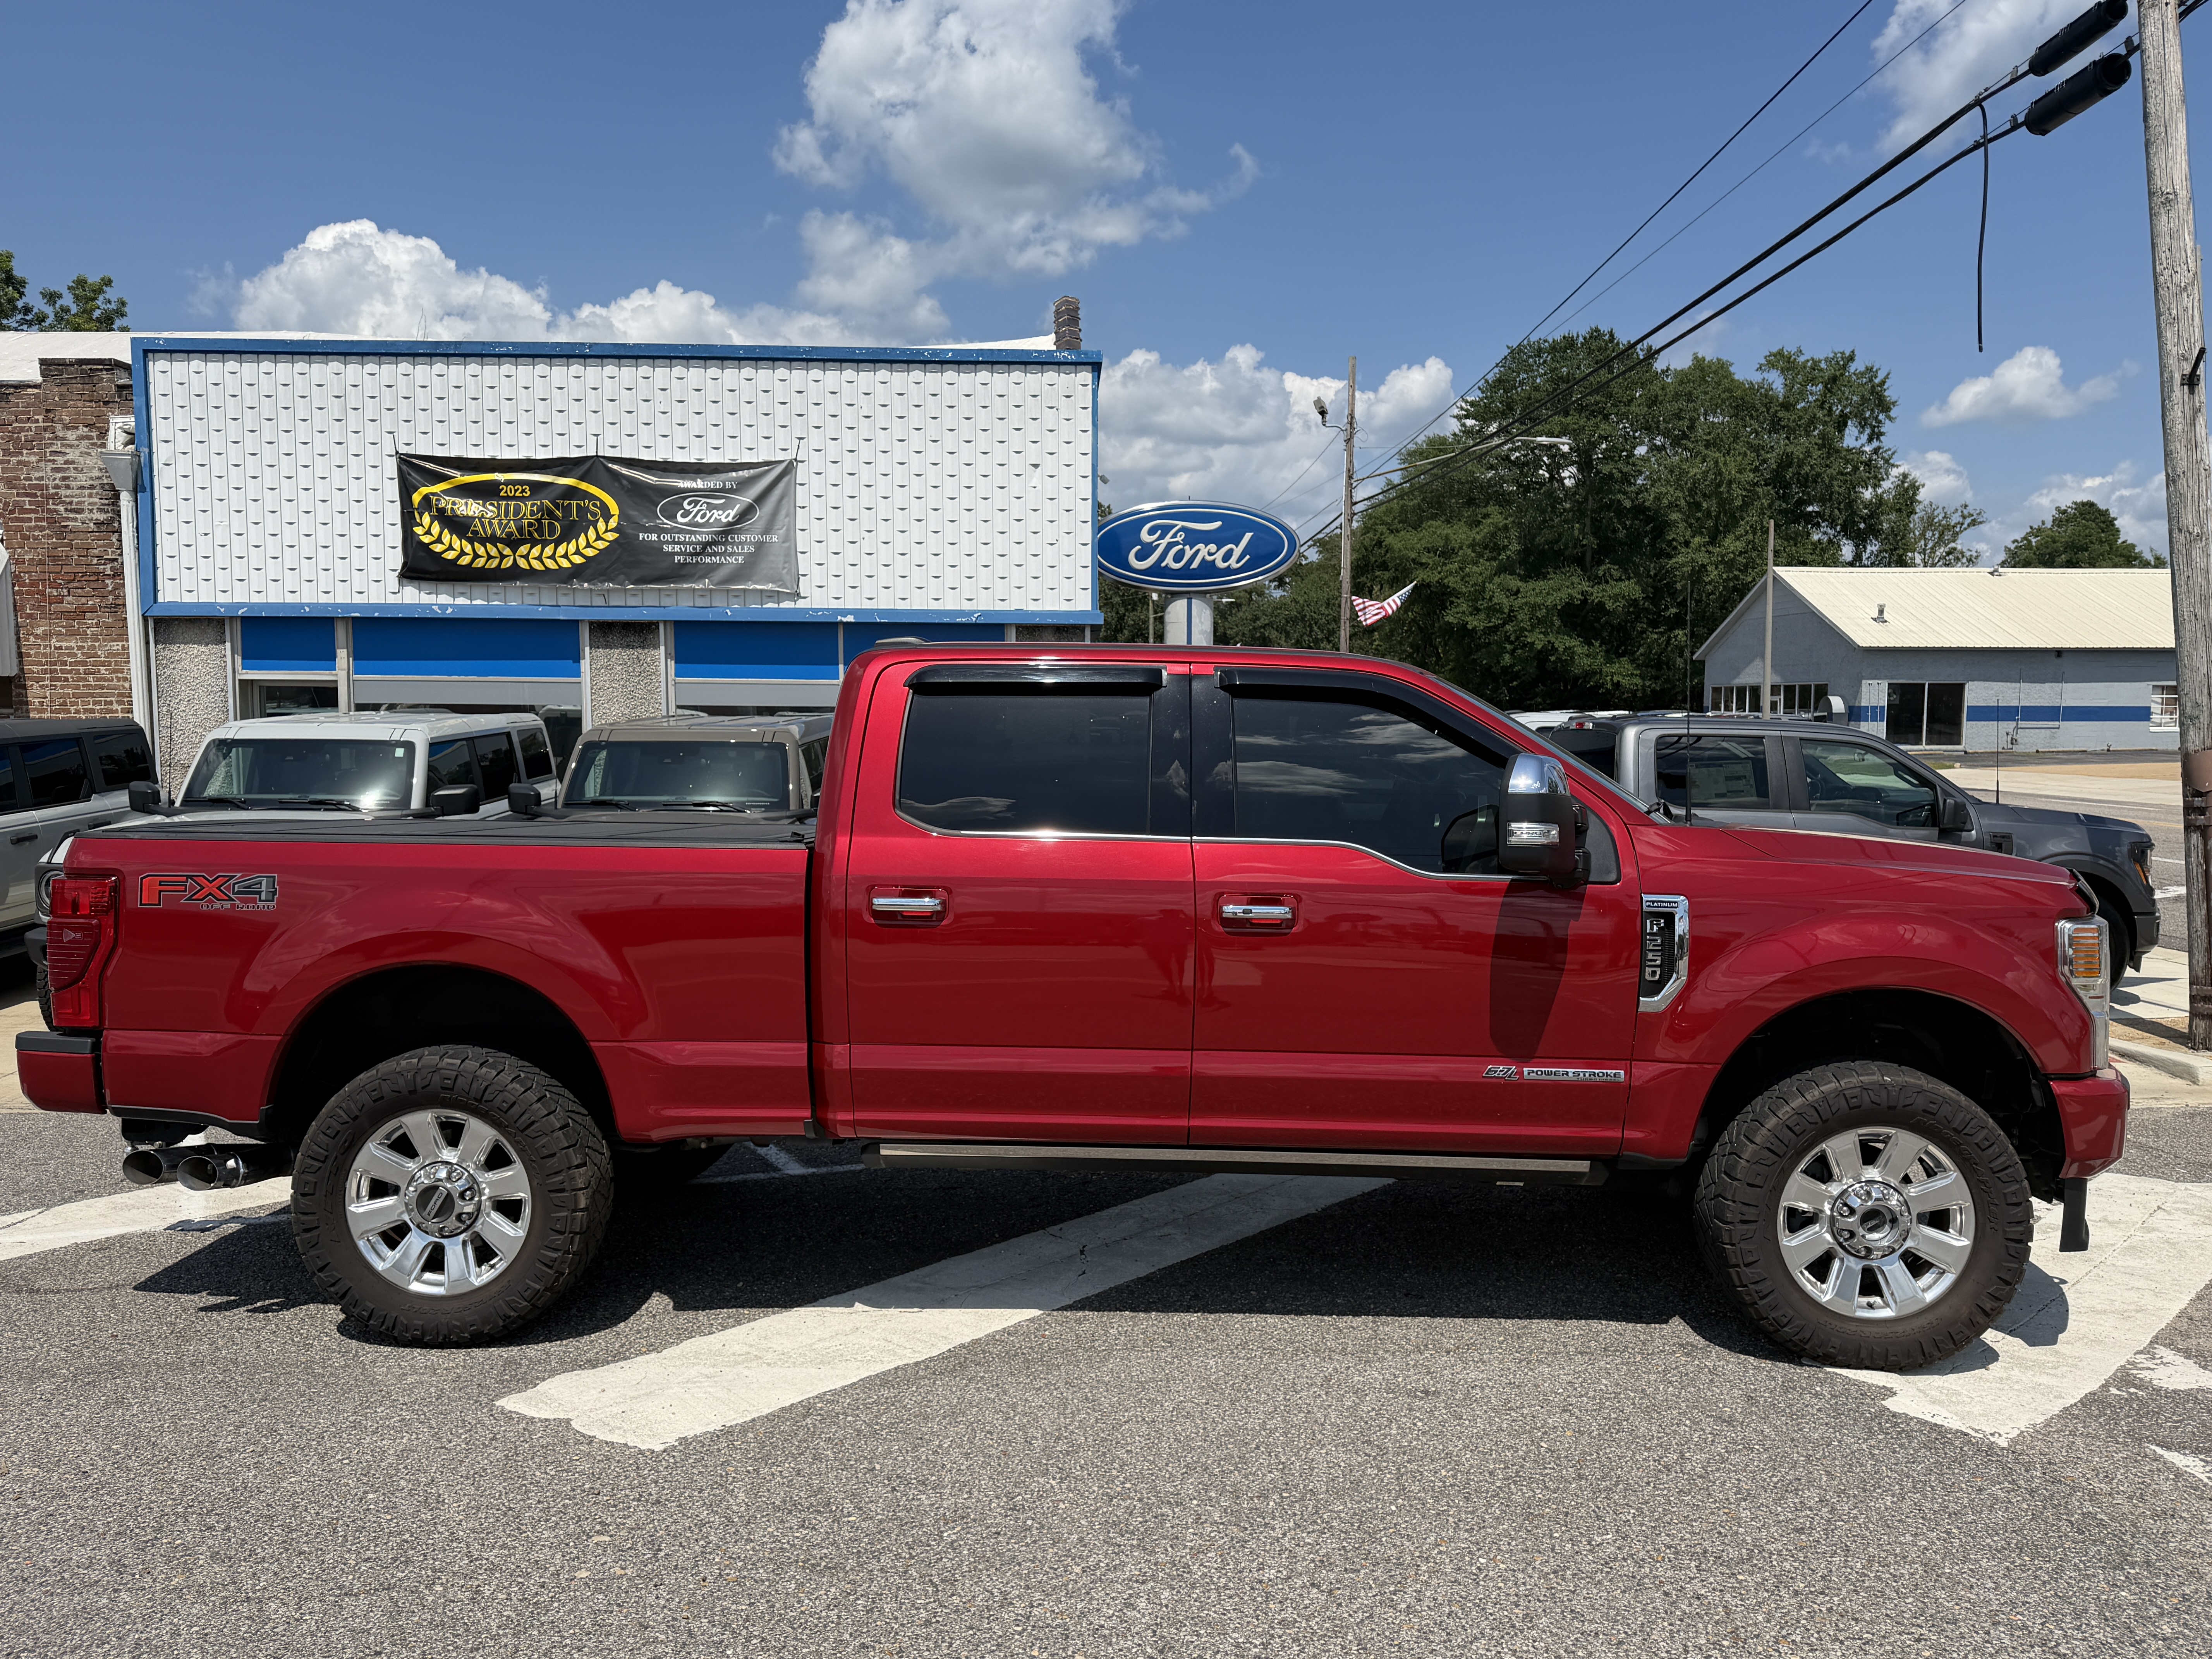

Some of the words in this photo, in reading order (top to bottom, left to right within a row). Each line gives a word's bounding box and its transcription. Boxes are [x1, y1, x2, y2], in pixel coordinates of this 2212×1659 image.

[499, 485, 530, 496] 2023
[429, 496, 601, 520] PRESIDENT'S
[677, 497, 740, 522] Ford
[467, 519, 561, 539] AWARD
[661, 534, 725, 542] OUTSTANDING
[663, 544, 702, 553] SERVICE
[1128, 520, 1254, 570] Ford
[138, 873, 278, 907] FX4
[1482, 1065, 1519, 1080] 6.7L
[427, 1192, 443, 1216] FORD
